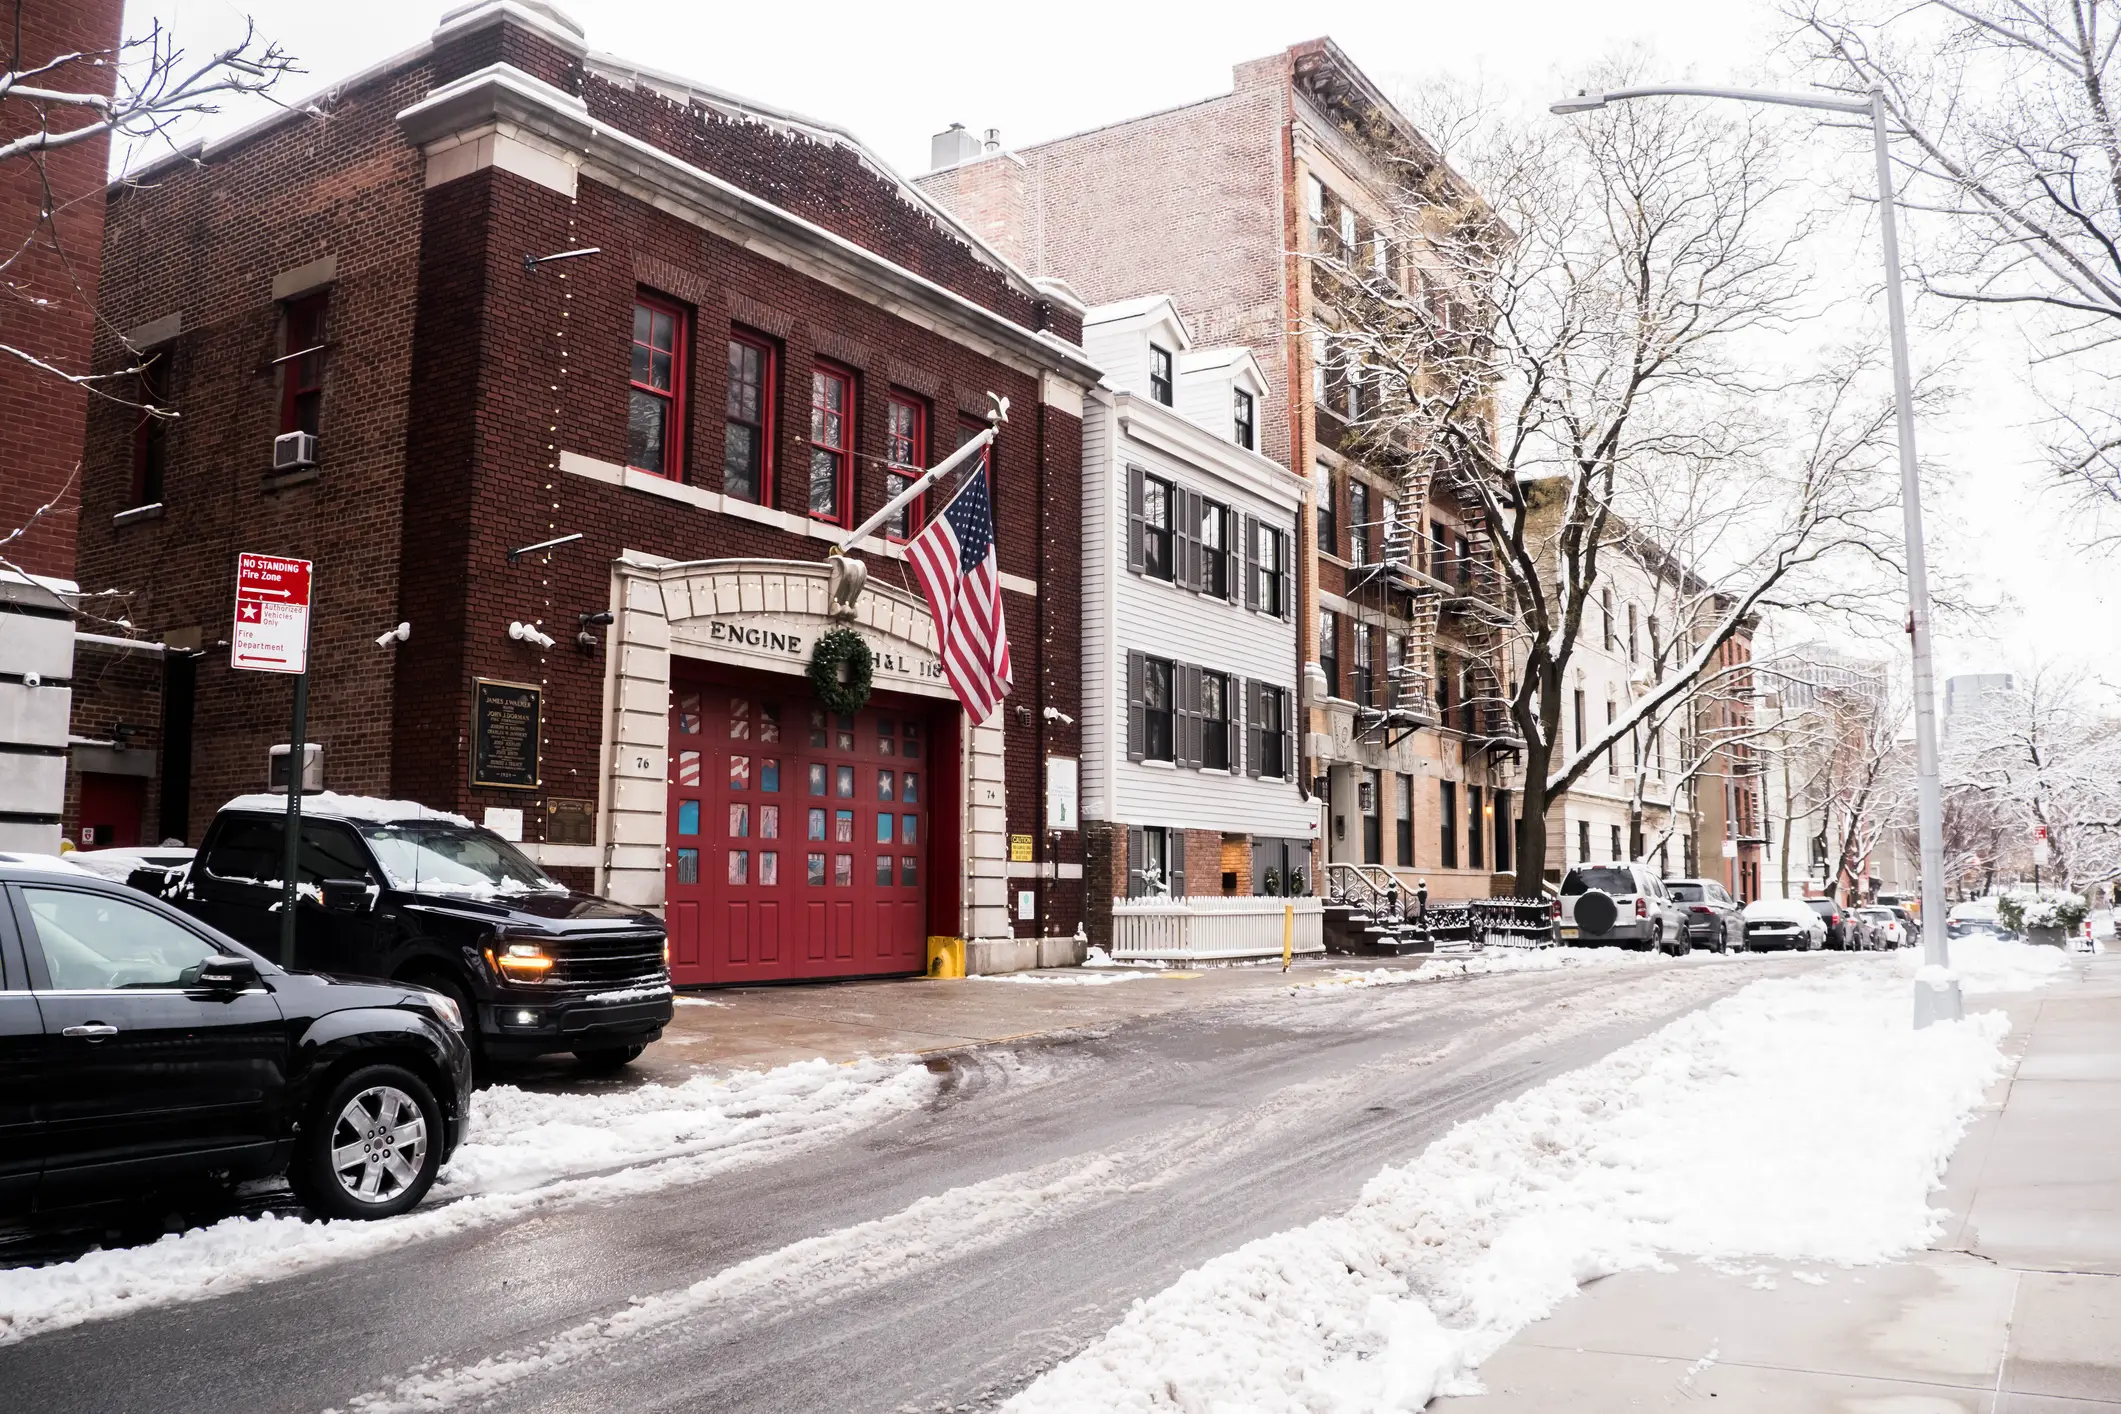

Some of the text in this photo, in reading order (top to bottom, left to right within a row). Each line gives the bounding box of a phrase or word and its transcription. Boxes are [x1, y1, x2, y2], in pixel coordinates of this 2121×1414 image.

[243, 559, 299, 573] NO STANDING
[242, 569, 281, 581] Fire Zone
[264, 603, 303, 614] Authorized
[264, 611, 293, 620] Vehicles
[263, 618, 278, 627] Only
[238, 630, 253, 638] Fire
[711, 620, 801, 654] ENGINE
[237, 640, 284, 652] Department
[636, 756, 650, 769] 76
[986, 790, 996, 799] 74
[1012, 836, 1032, 844] CAUTION
